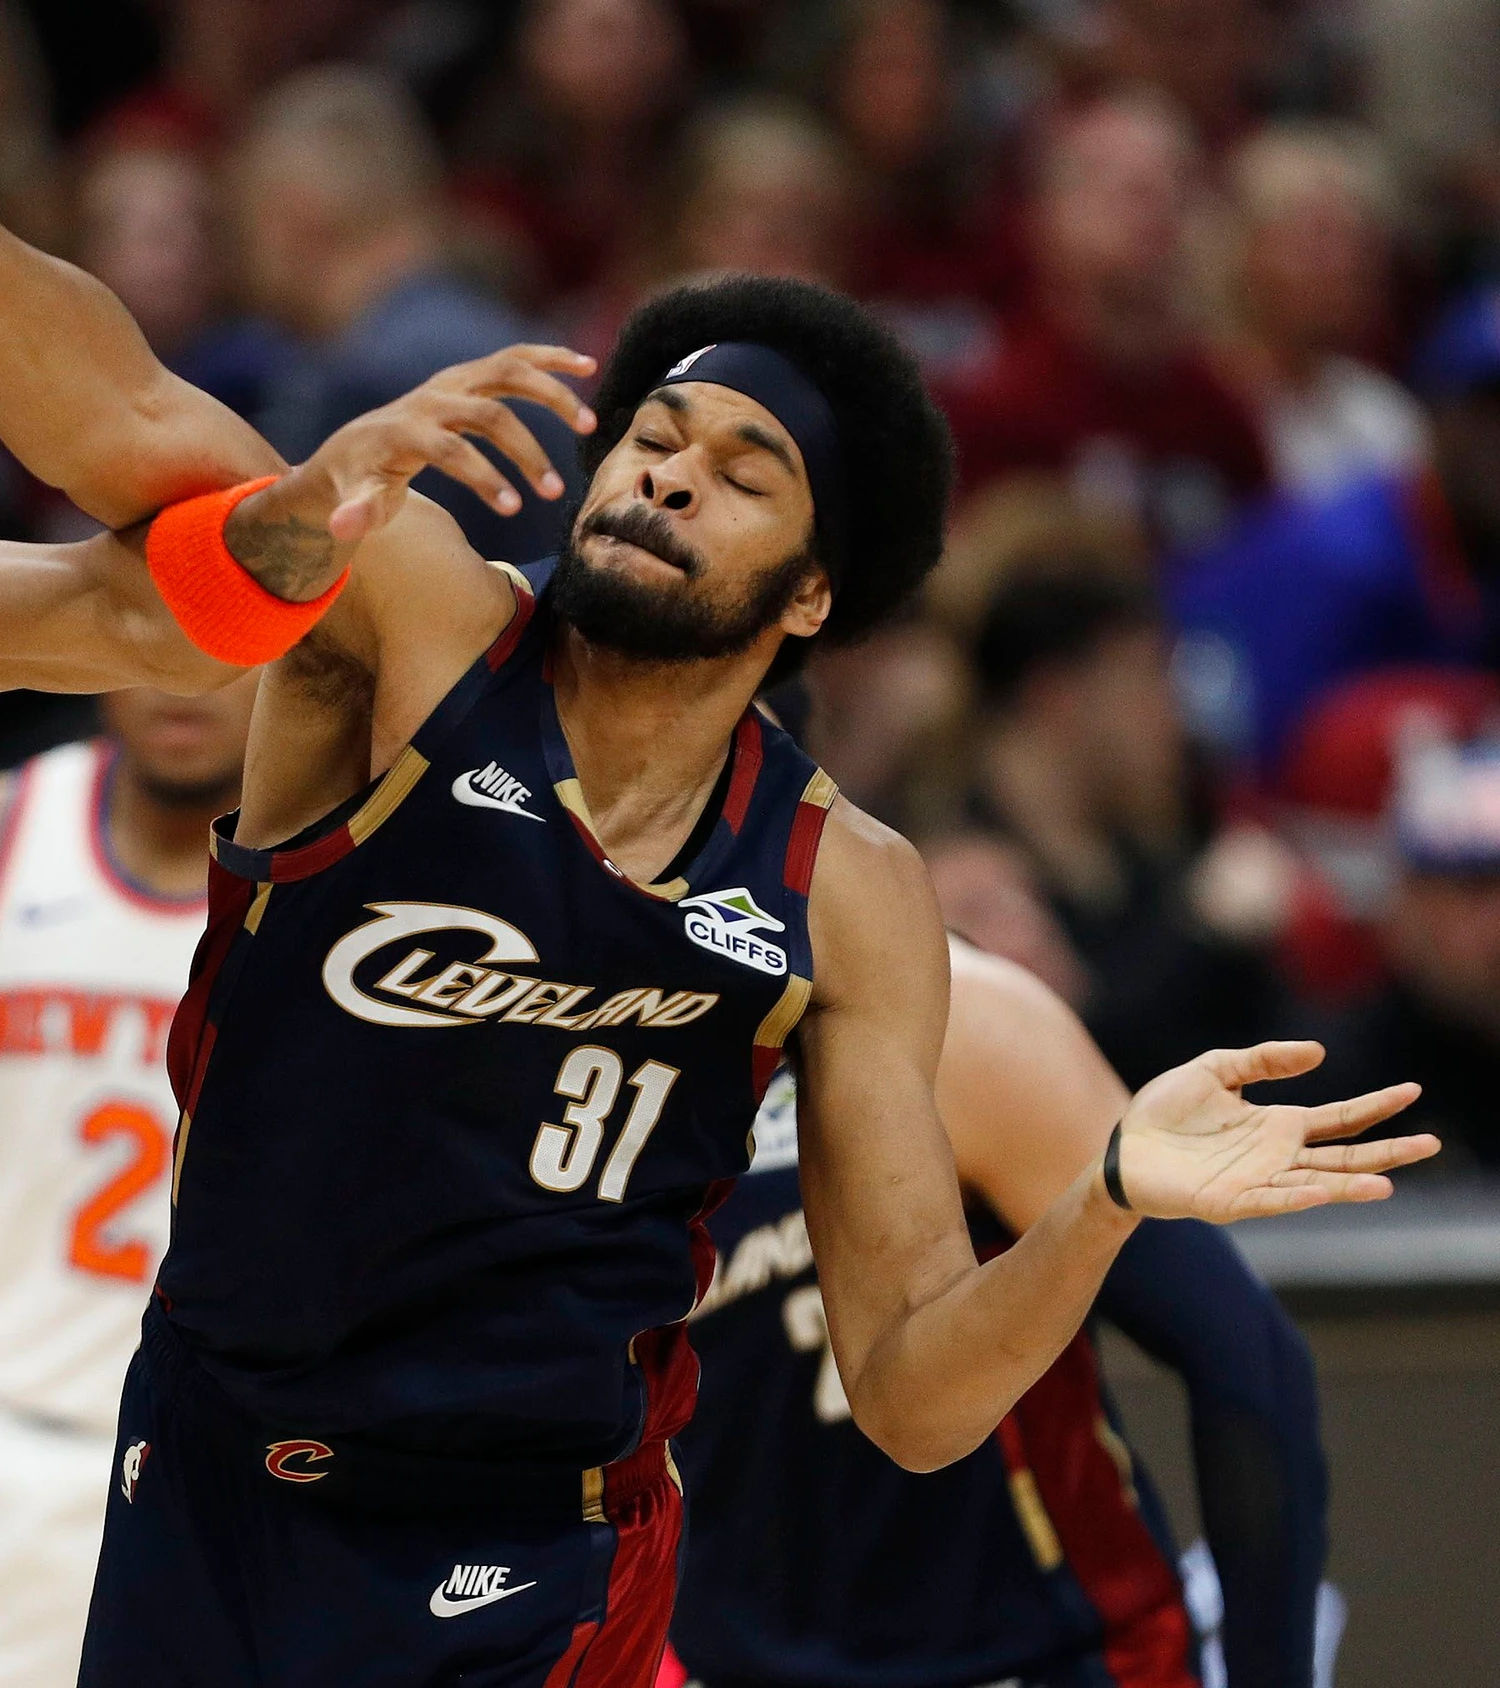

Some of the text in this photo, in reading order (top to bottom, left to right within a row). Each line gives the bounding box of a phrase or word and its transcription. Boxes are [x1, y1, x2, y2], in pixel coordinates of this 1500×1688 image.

[472, 760, 532, 810] NIKE
[689, 920, 783, 969] CLIFFS
[528, 1044, 681, 1204] 31
[445, 1564, 512, 1597] NIKE
